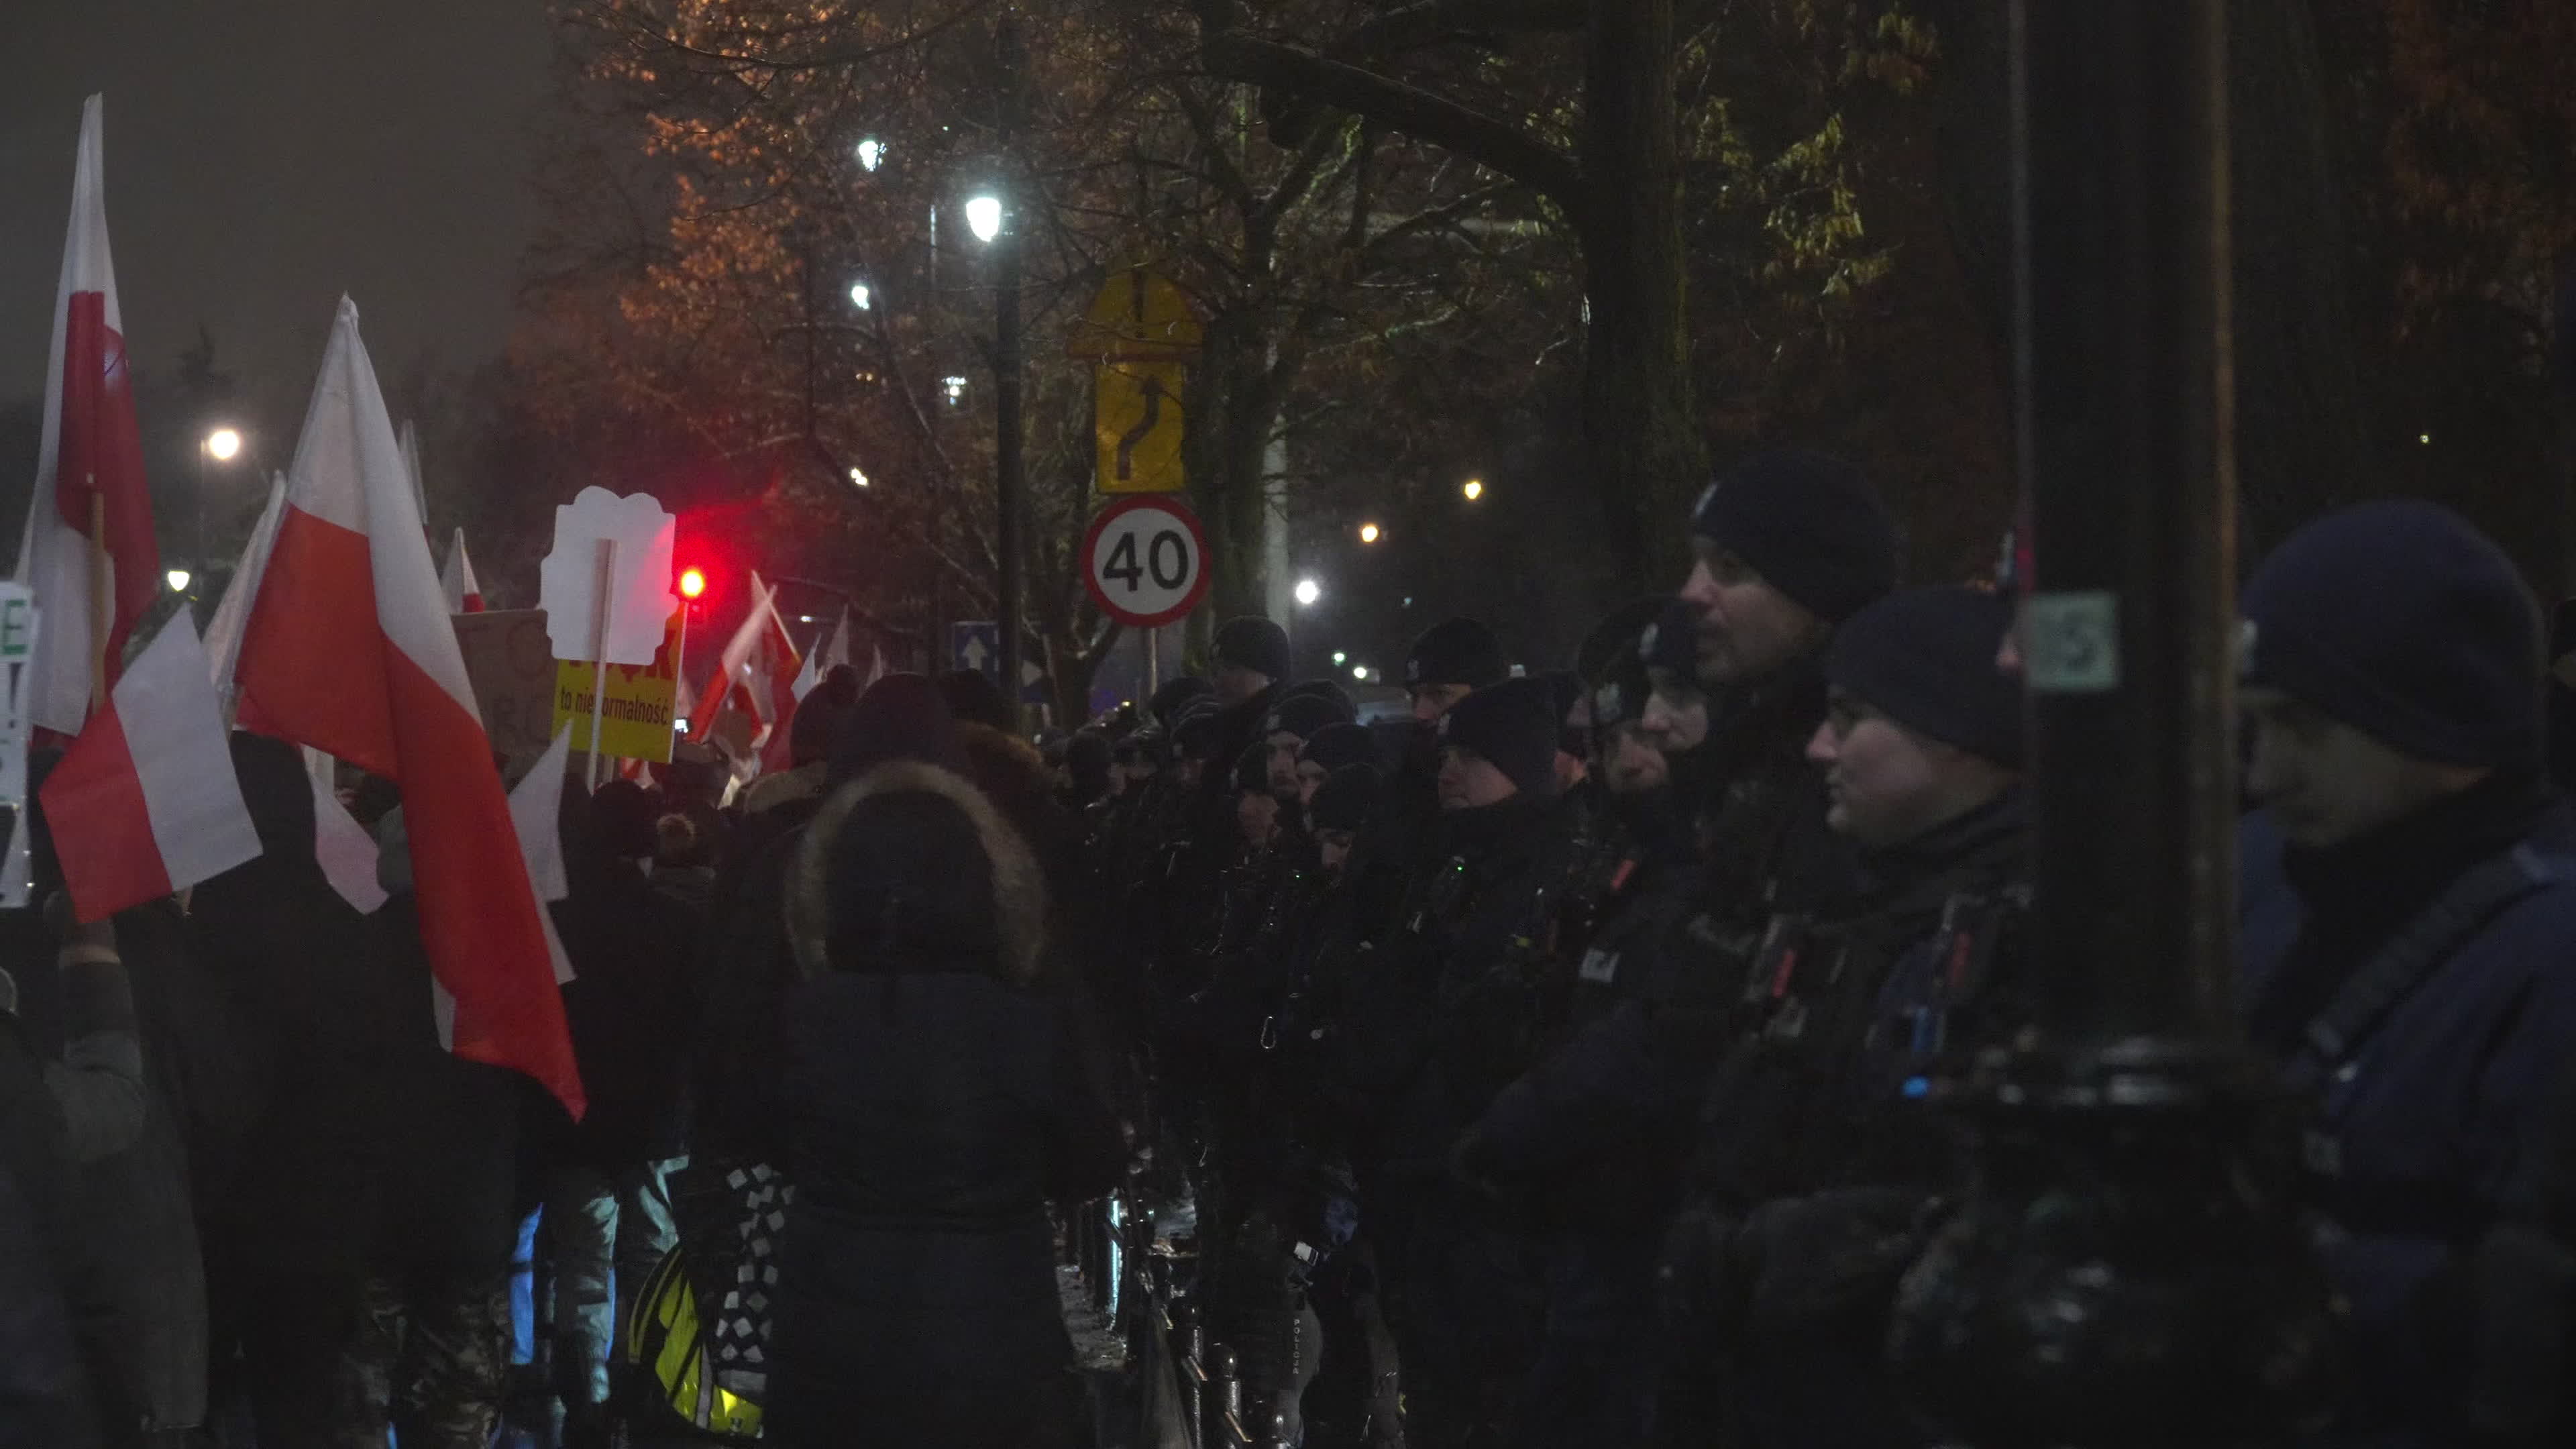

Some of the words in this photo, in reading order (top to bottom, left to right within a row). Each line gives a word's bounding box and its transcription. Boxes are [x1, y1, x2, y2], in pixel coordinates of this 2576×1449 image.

[1103, 529, 1189, 592] 40
[560, 686, 572, 711] to
[1292, 1318, 1301, 1375] POLICJA
